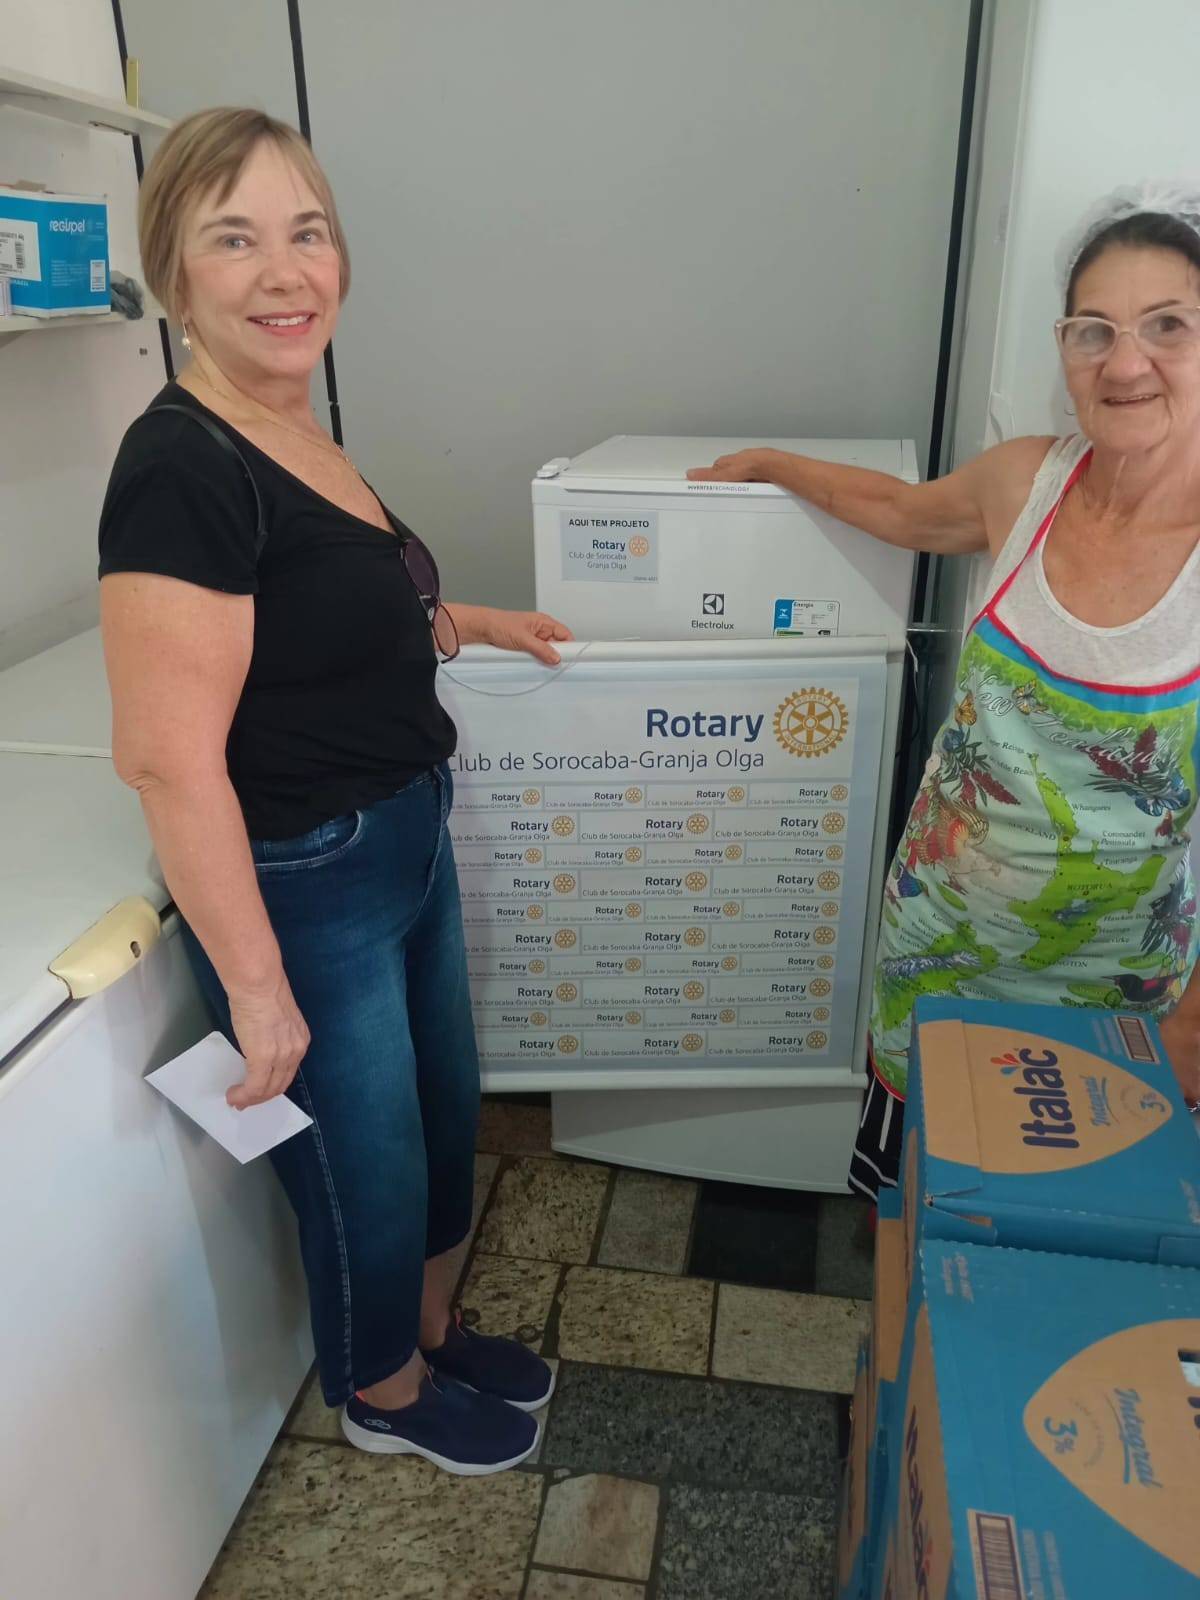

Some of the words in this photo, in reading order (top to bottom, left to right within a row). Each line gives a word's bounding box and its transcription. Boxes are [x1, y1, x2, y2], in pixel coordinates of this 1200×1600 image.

[569, 519, 589, 527] AQUI
[591, 519, 608, 528] TEM
[610, 520, 650, 528] PROJETO
[592, 539, 626, 552] Rotary
[568, 551, 585, 559] Club
[586, 552, 594, 560] de
[691, 620, 734, 630] Electrolux
[647, 708, 764, 743] Rotary
[500, 752, 525, 770] de
[533, 750, 708, 773] Sorocaba-Granja
[716, 749, 764, 772] Olga
[800, 789, 828, 797] Rotary
[492, 794, 520, 802] Rotary
[511, 822, 548, 832] Rotary
[646, 819, 683, 830] Rotary
[781, 817, 818, 828] Rotary
[611, 832, 666, 840] Sorocaba-Granja
[745, 830, 800, 838] Sorocaba-Granja
[803, 830, 819, 838] Olga
[595, 851, 623, 859] Rotary
[795, 848, 823, 857] Rotary
[514, 879, 550, 889] Rotary
[646, 877, 682, 887] Rotary
[777, 875, 814, 886] Rotary
[596, 907, 623, 915] Rotary
[792, 904, 819, 912] Rotary
[516, 935, 551, 944] Rotary
[645, 933, 681, 942] Rotary
[774, 930, 810, 940] Rotary
[692, 960, 719, 968] Rotary
[518, 988, 553, 998] Rotary
[645, 986, 679, 996] Rotary
[772, 984, 806, 993] Rotary
[520, 1040, 554, 1049] Rotary
[645, 1039, 679, 1048] Rotary
[769, 1037, 803, 1046] Rotary
[1013, 1048, 1080, 1149] Italac
[1043, 1416, 1079, 1455] 3%
[1113, 1387, 1165, 1489] Integral
